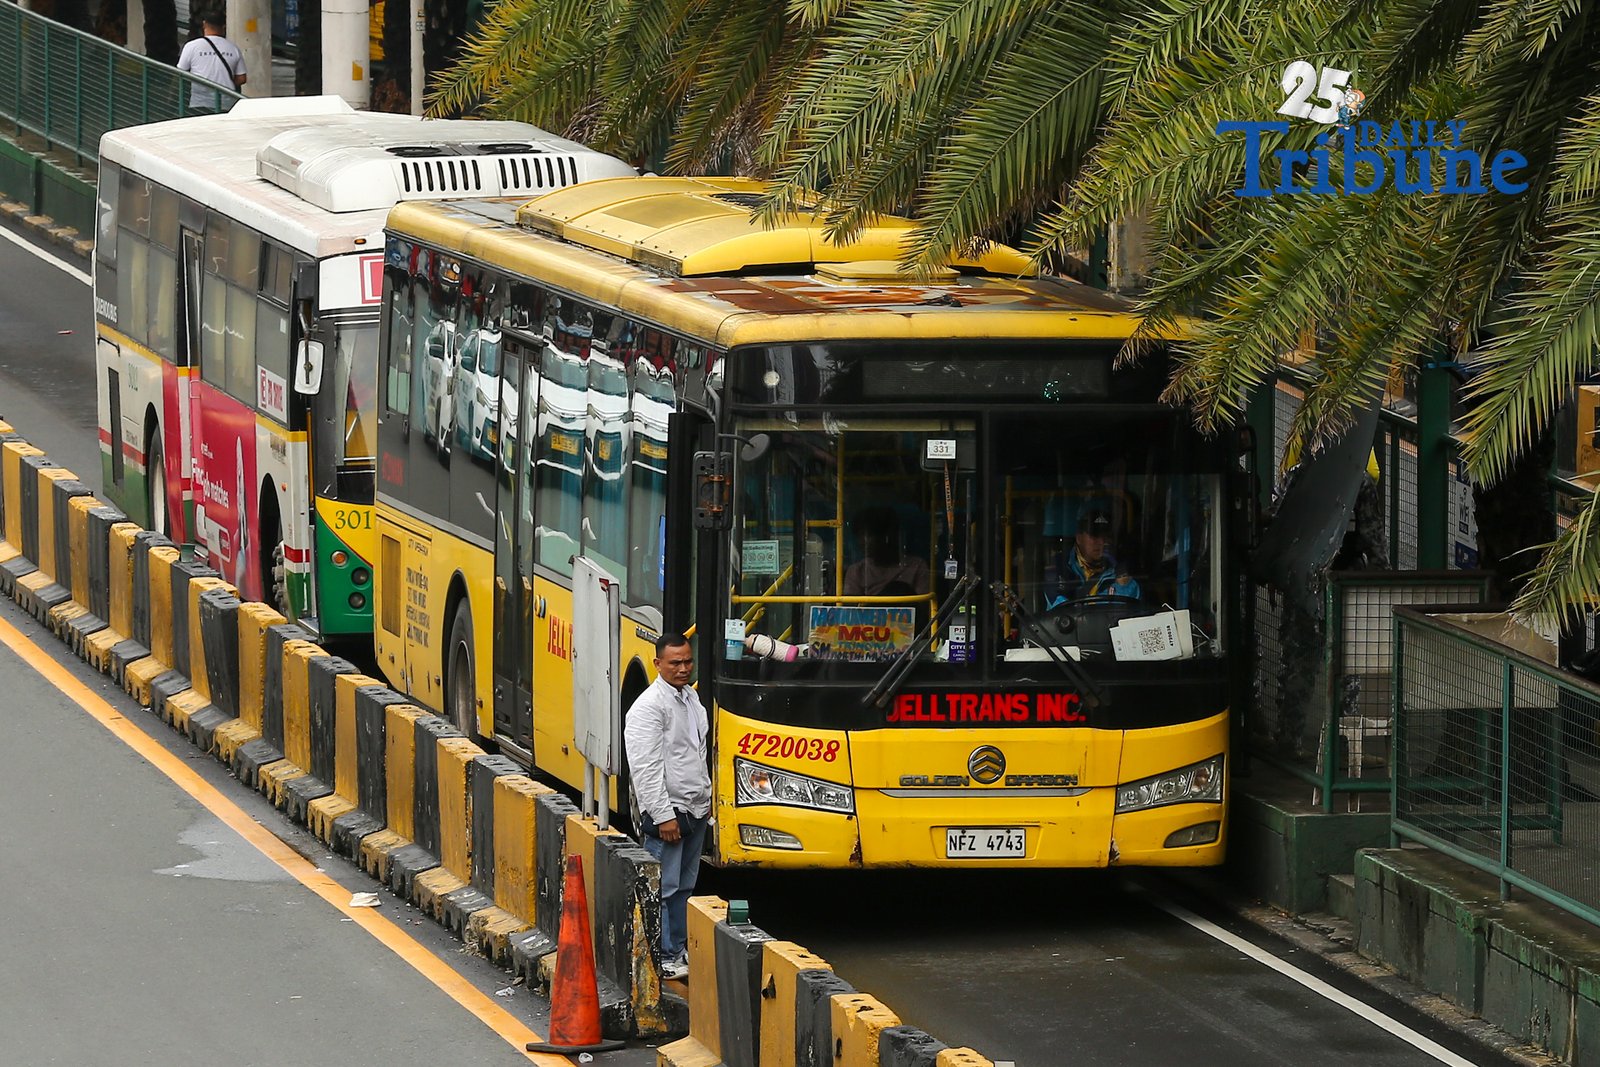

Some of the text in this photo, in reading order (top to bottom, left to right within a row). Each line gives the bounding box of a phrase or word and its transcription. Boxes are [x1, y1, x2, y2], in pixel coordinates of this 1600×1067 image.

[335, 510, 372, 529] 301
[547, 614, 566, 660] JELL
[838, 626, 890, 642] MCU
[886, 693, 1087, 722] JELL TRANS INC.
[737, 733, 840, 763] 4720038
[900, 775, 1079, 787] GOLDEN DRAGON
[949, 835, 1023, 851] NFZ 4743
